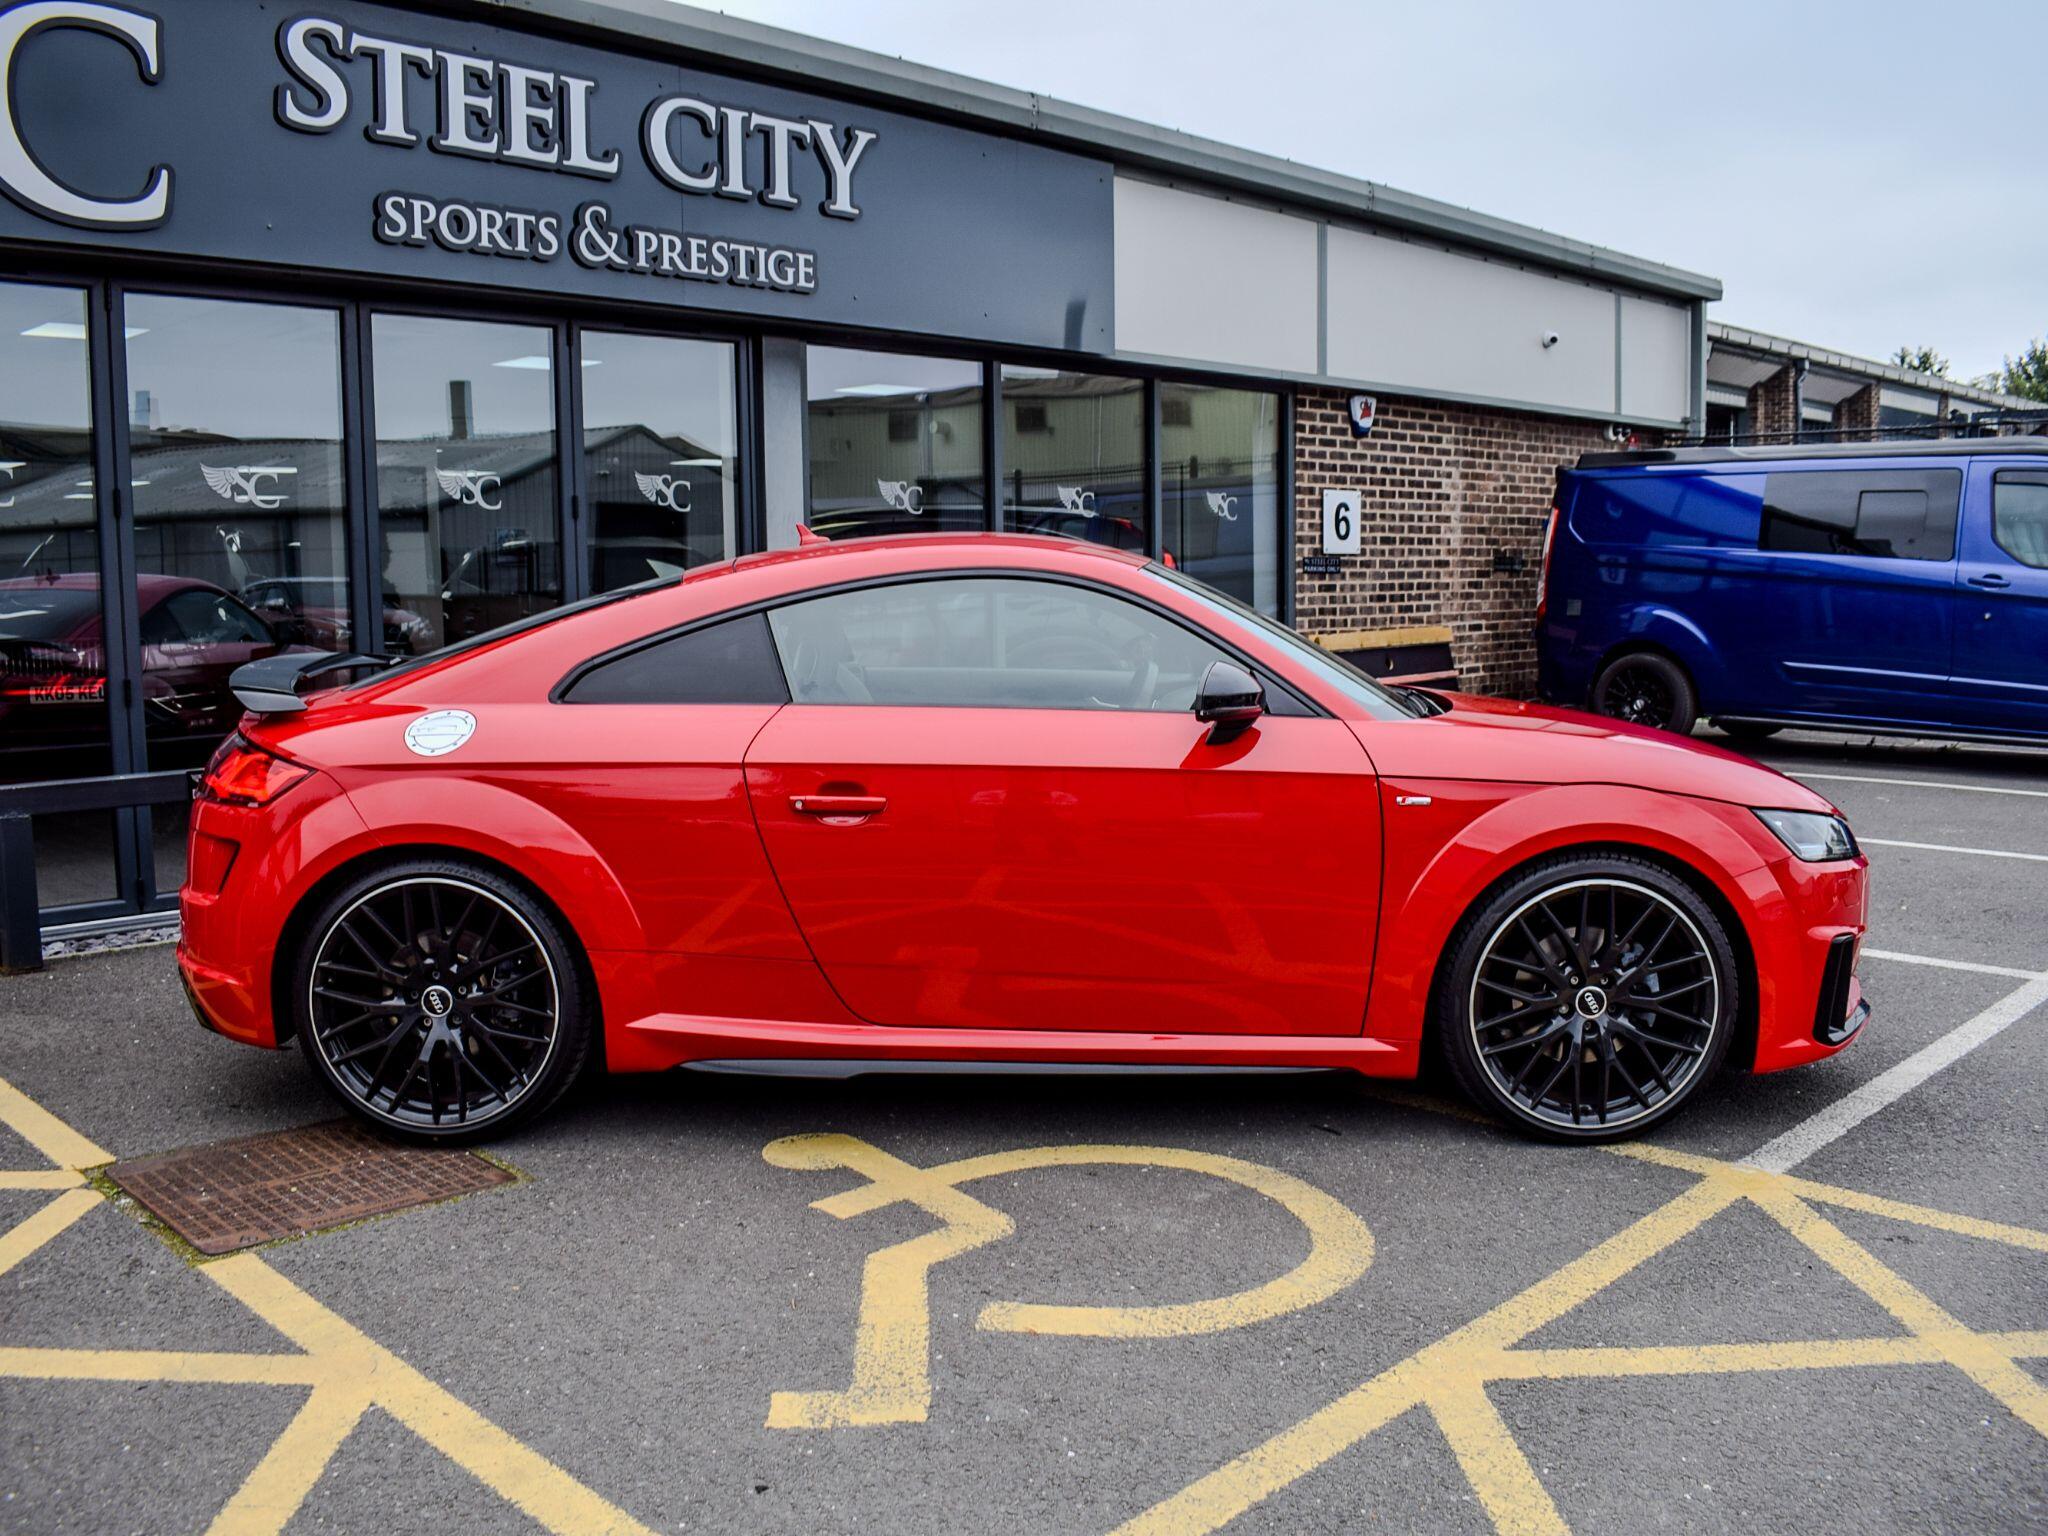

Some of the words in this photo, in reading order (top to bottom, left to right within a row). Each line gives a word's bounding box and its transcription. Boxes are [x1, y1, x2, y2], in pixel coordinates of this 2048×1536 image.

[285, 17, 620, 175] STEEL
[648, 97, 878, 216] CITY
[383, 196, 559, 256] SPORTS
[578, 204, 628, 266] &
[635, 230, 816, 289] PRESTIGE
[657, 474, 692, 512] SC
[896, 481, 923, 515] SC
[1217, 492, 1238, 521] SC
[1334, 502, 1351, 541] 6
